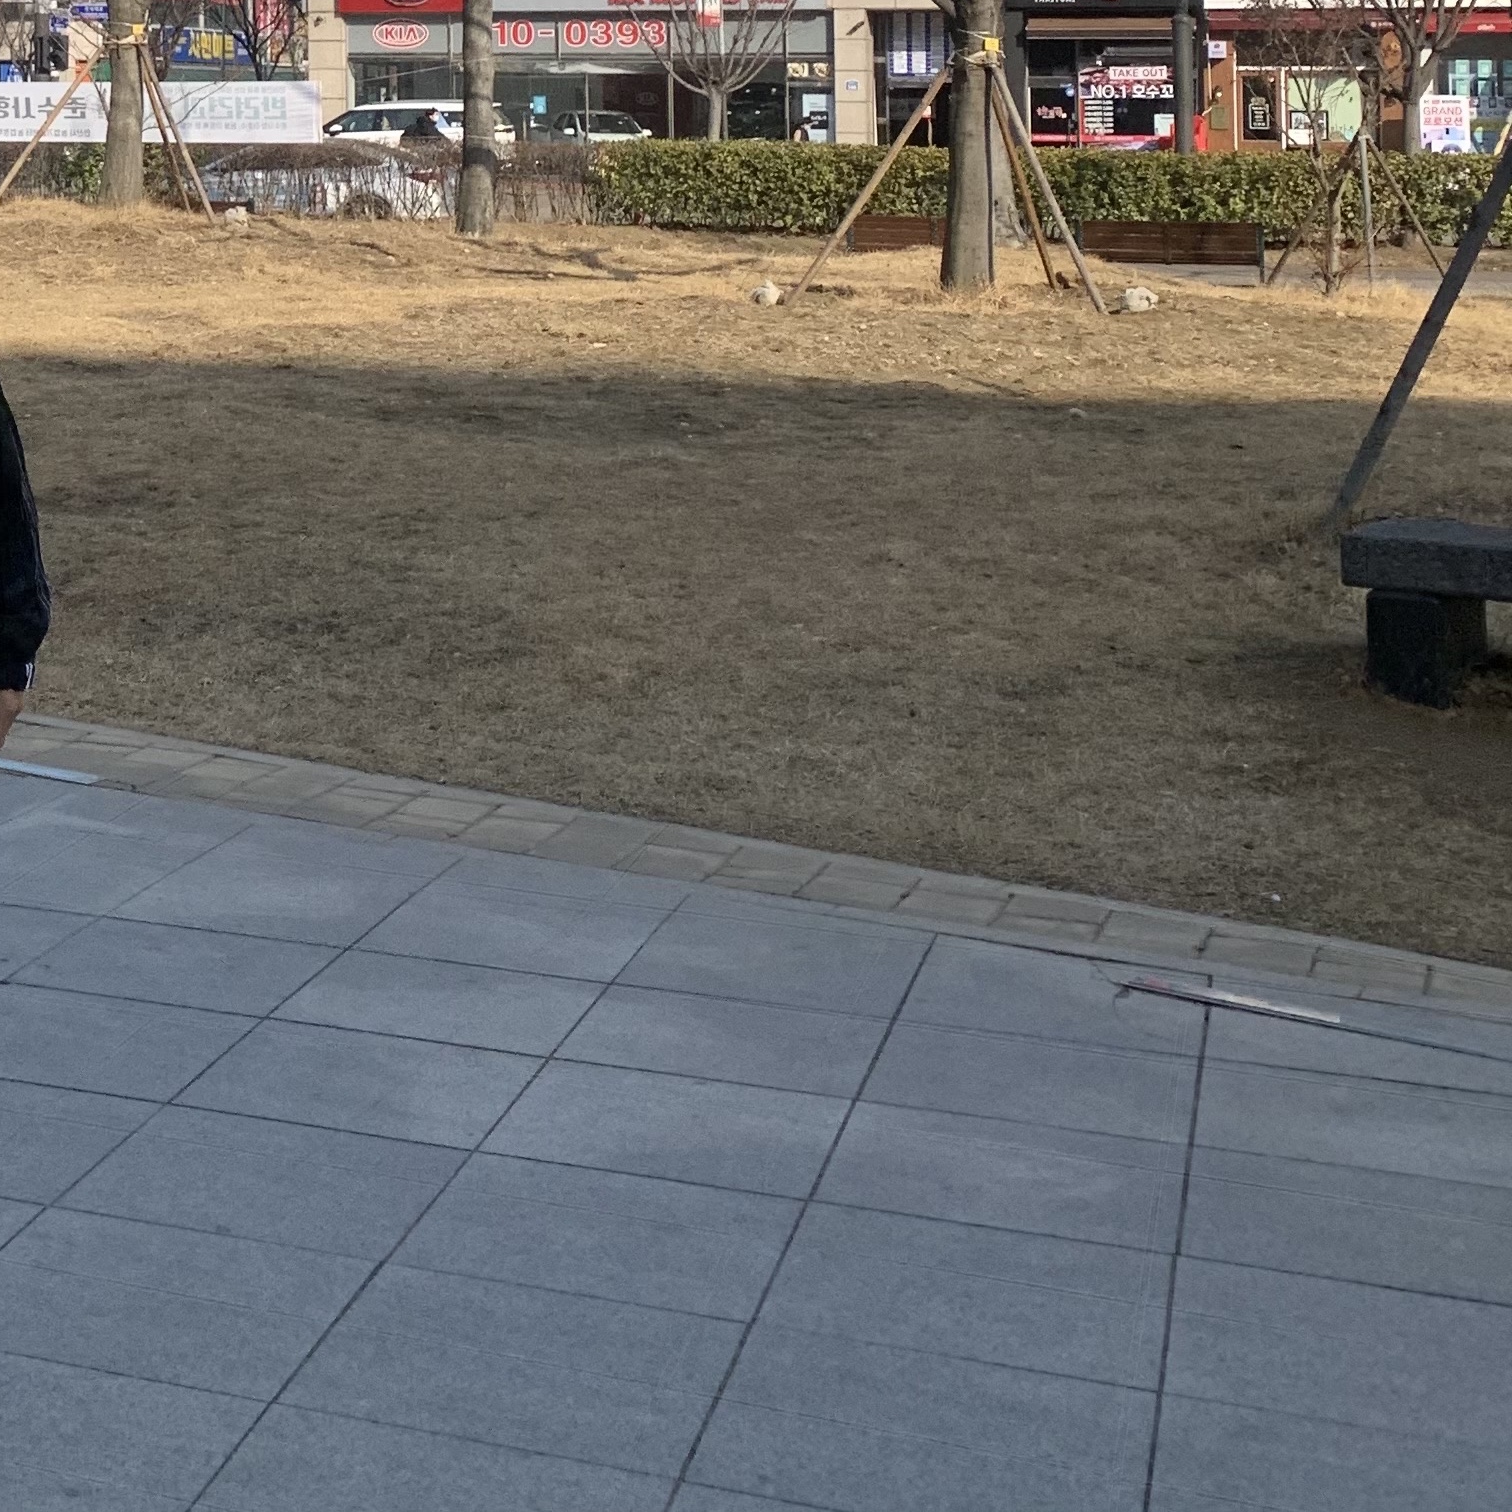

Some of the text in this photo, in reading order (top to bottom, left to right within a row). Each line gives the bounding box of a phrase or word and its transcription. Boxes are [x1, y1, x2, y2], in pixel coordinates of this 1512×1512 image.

[383, 24, 420, 40] KIA
[1111, 67, 1165, 78] TAKE OUT
[1090, 84, 1174, 99] NO.1 호수꼬
[1423, 107, 1463, 116] GRAND
[1423, 116, 1463, 127] 프로모션
